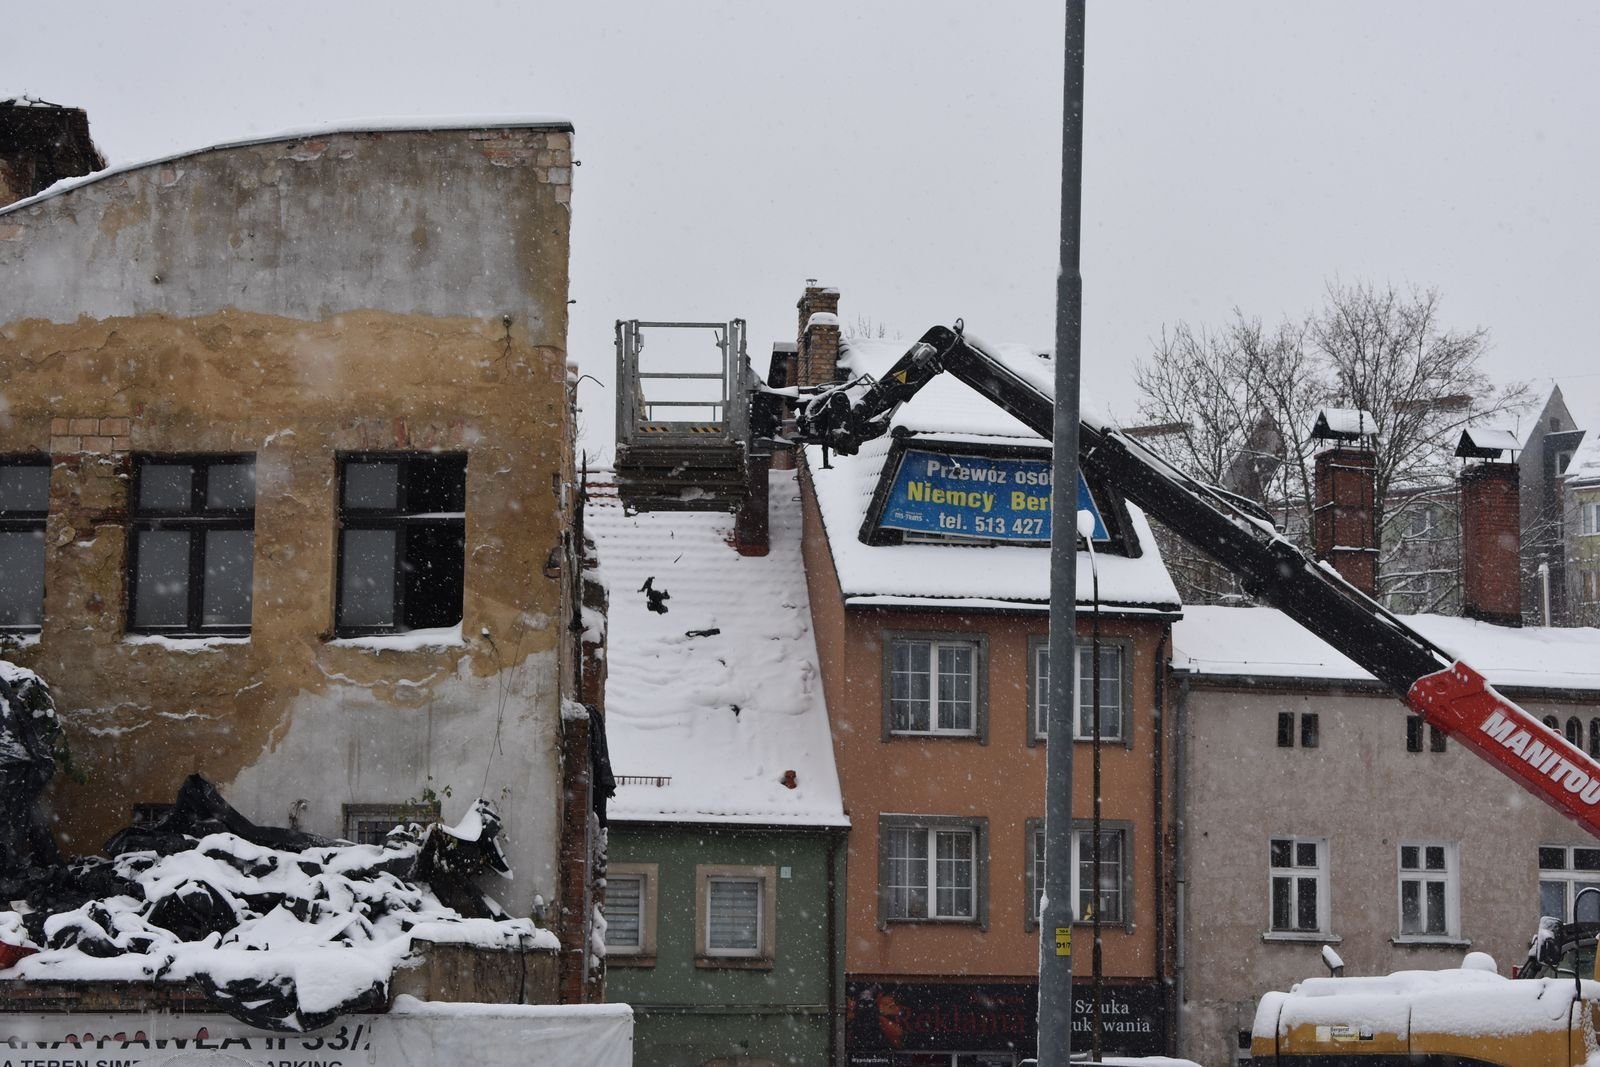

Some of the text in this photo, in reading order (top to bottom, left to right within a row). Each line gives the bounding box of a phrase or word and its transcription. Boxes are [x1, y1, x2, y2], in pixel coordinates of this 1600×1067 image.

[927, 460, 1053, 486] Przewóz osó
[907, 481, 1051, 513] Niemcy Ber
[939, 512, 1043, 535] tel. 513 427
[1480, 711, 1600, 805] MANITOU
[1075, 999, 1130, 1014] Szuka
